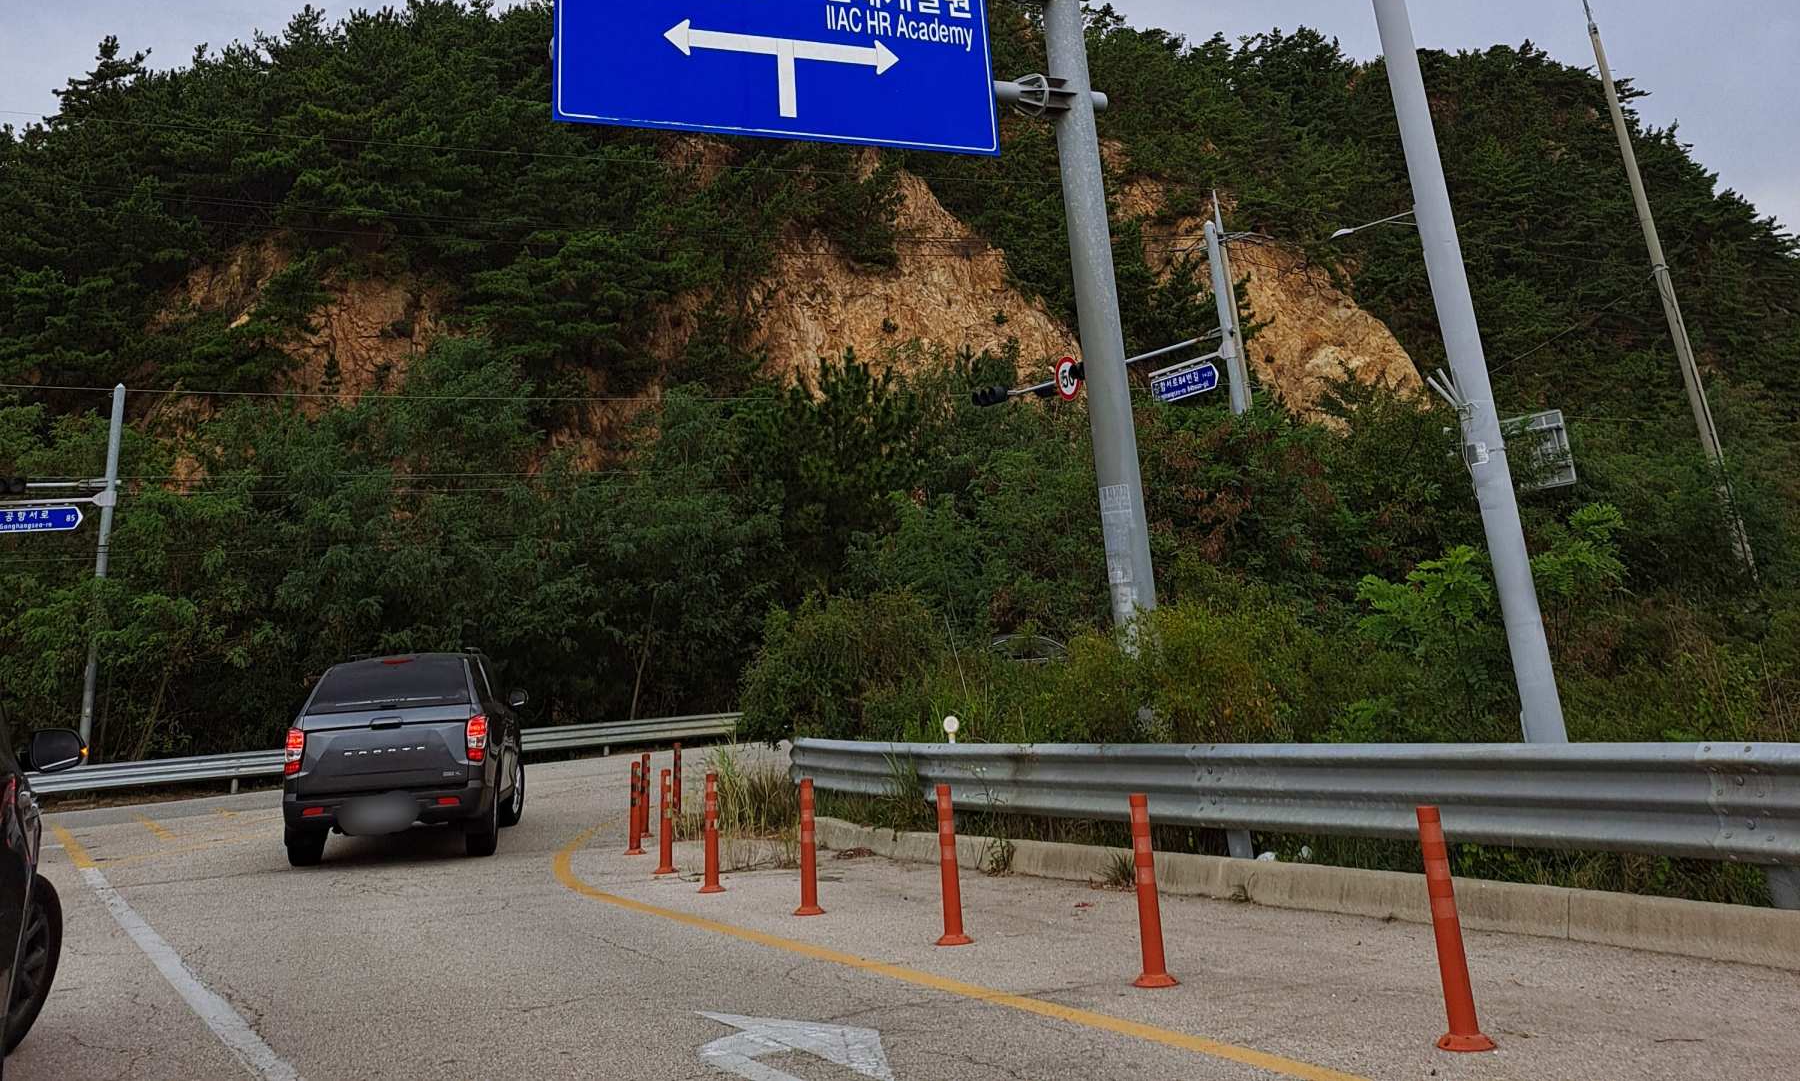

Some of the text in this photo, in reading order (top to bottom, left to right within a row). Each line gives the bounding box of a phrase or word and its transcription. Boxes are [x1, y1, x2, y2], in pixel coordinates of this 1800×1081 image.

[825, 4, 973, 52] IIAC HR Academy
[4, 510, 50, 522] 공항서로
[65, 514, 76, 522] 85
